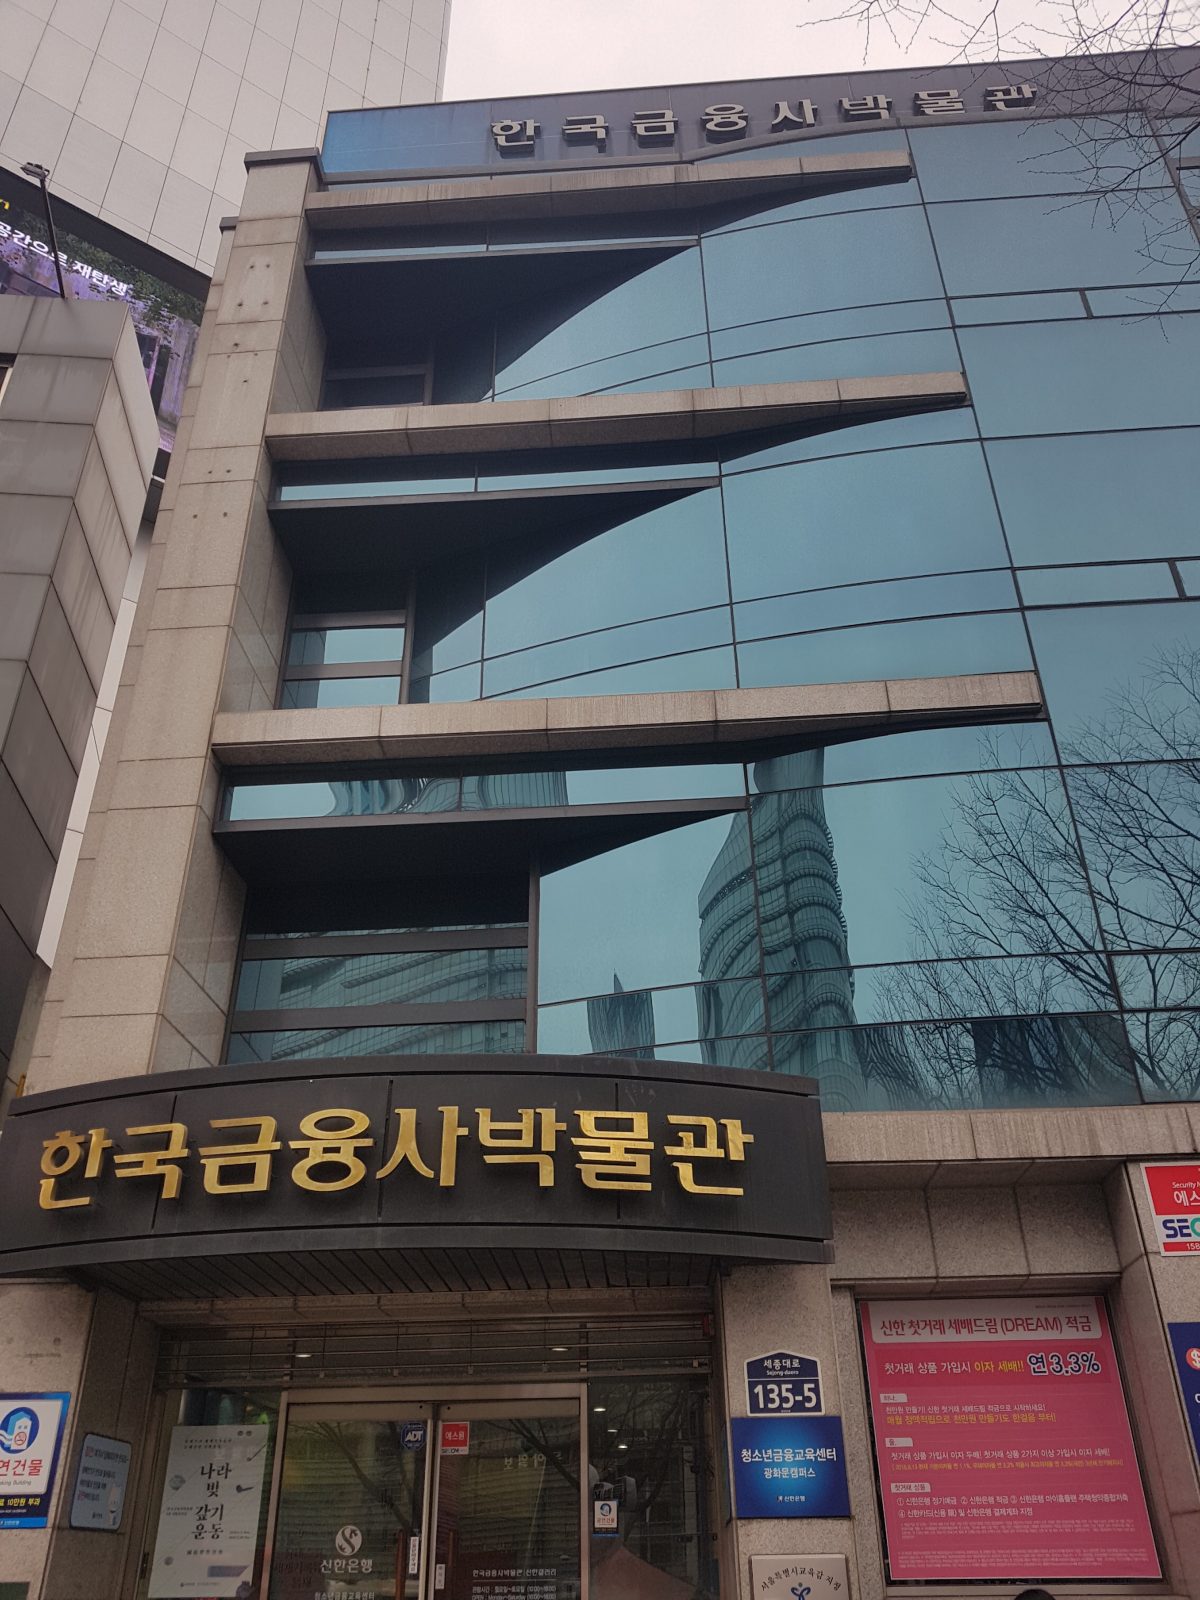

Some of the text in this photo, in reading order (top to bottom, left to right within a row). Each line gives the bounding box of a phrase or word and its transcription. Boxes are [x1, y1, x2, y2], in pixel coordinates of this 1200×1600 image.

[490, 84, 1038, 147] 한국금융사박물관
[72, 260, 128, 296] 재탄생
[38, 1106, 755, 1211] 한국금융사박물관
[879, 1319, 905, 1337] 신한
[908, 1318, 945, 1337] 첫거래
[1065, 1315, 1092, 1333] 적금
[763, 1359, 800, 1370] 세종대로
[884, 1362, 914, 1375] 첫거래
[917, 1362, 938, 1374] 상품
[941, 1361, 971, 1374] 가입시
[974, 1361, 994, 1373] 이자
[1027, 1353, 1048, 1376] 연
[1049, 1351, 1101, 1376] 3.3%
[753, 1383, 817, 1409] 135-5
[405, 1430, 423, 1441] ADT
[741, 1448, 837, 1463] 청소년금융교육센터
[200, 1462, 233, 1479] 나라
[763, 1467, 816, 1479] 광화문캠퍼스
[206, 1480, 220, 1498] 빚
[195, 1503, 224, 1521] 갚기
[191, 1522, 224, 1540] 운동
[320, 1558, 373, 1574] 신한은행
